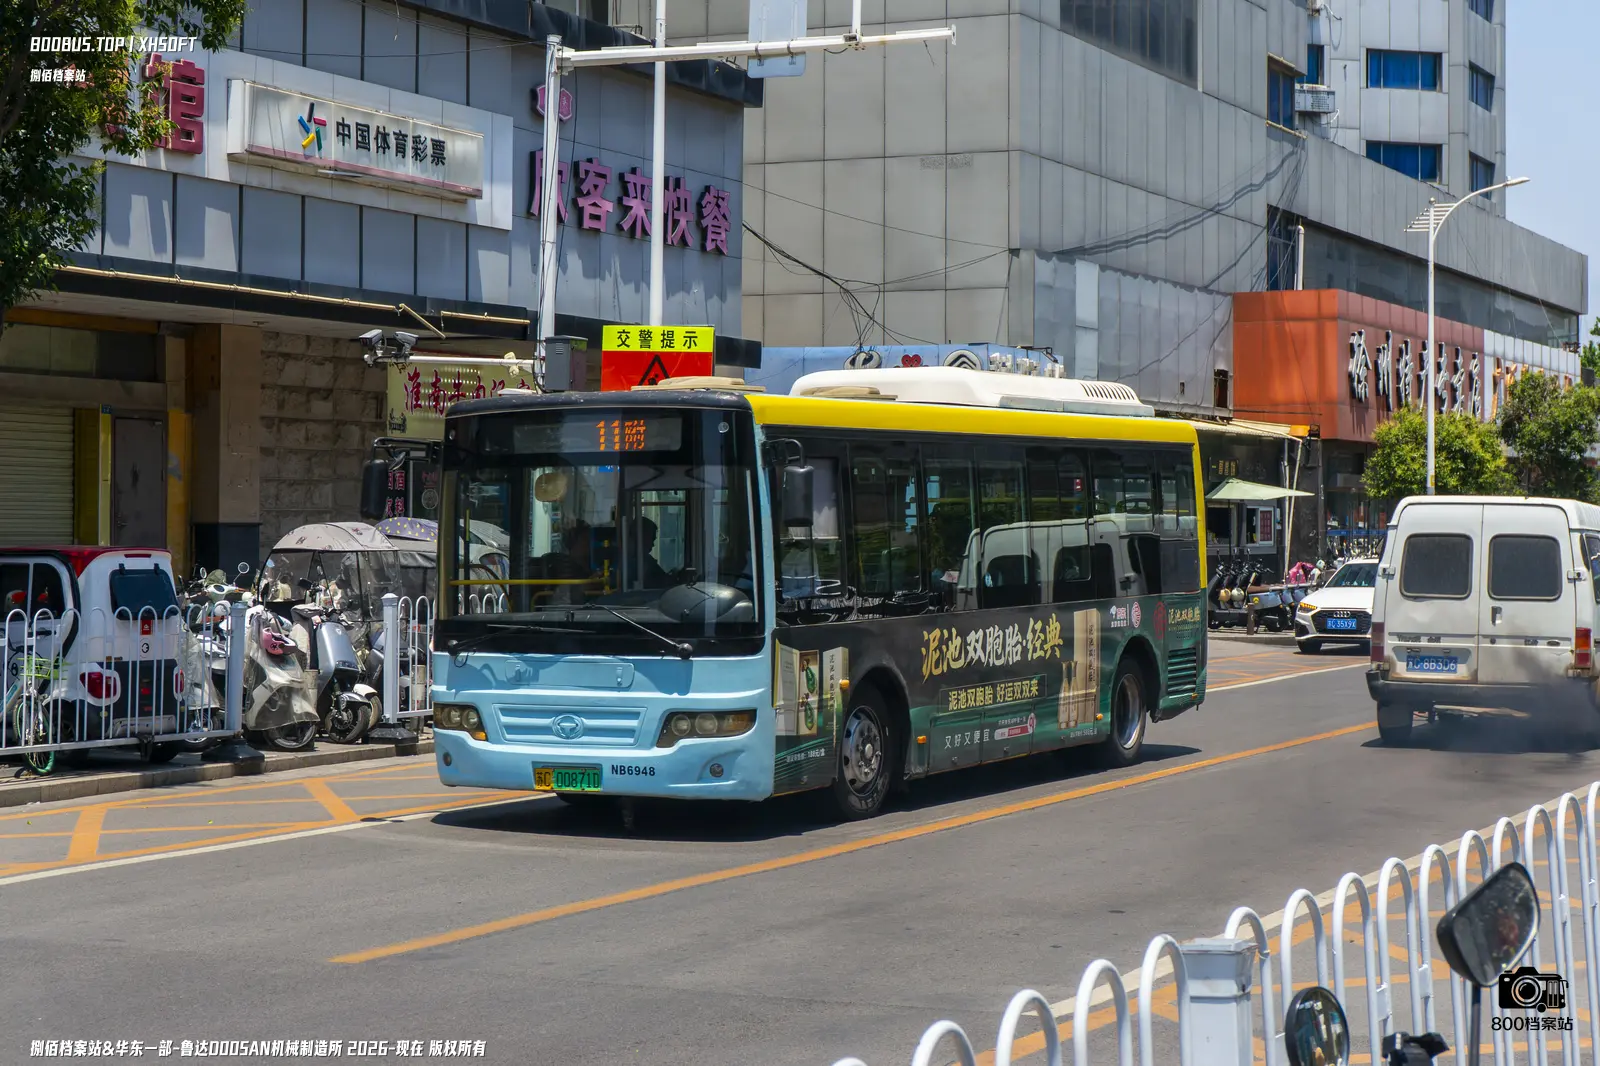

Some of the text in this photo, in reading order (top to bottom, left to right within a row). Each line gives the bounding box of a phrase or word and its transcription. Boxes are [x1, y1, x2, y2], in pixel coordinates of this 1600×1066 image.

[336, 117, 446, 166] 中国体育彩票
[616, 329, 699, 349] 交警提示
[404, 366, 532, 415] 淮南牛肉
[948, 679, 1039, 711] 泥池双胞胎 好运双双来
[944, 729, 990, 749] 又好又便宜
[611, 764, 656, 777] NB6948
